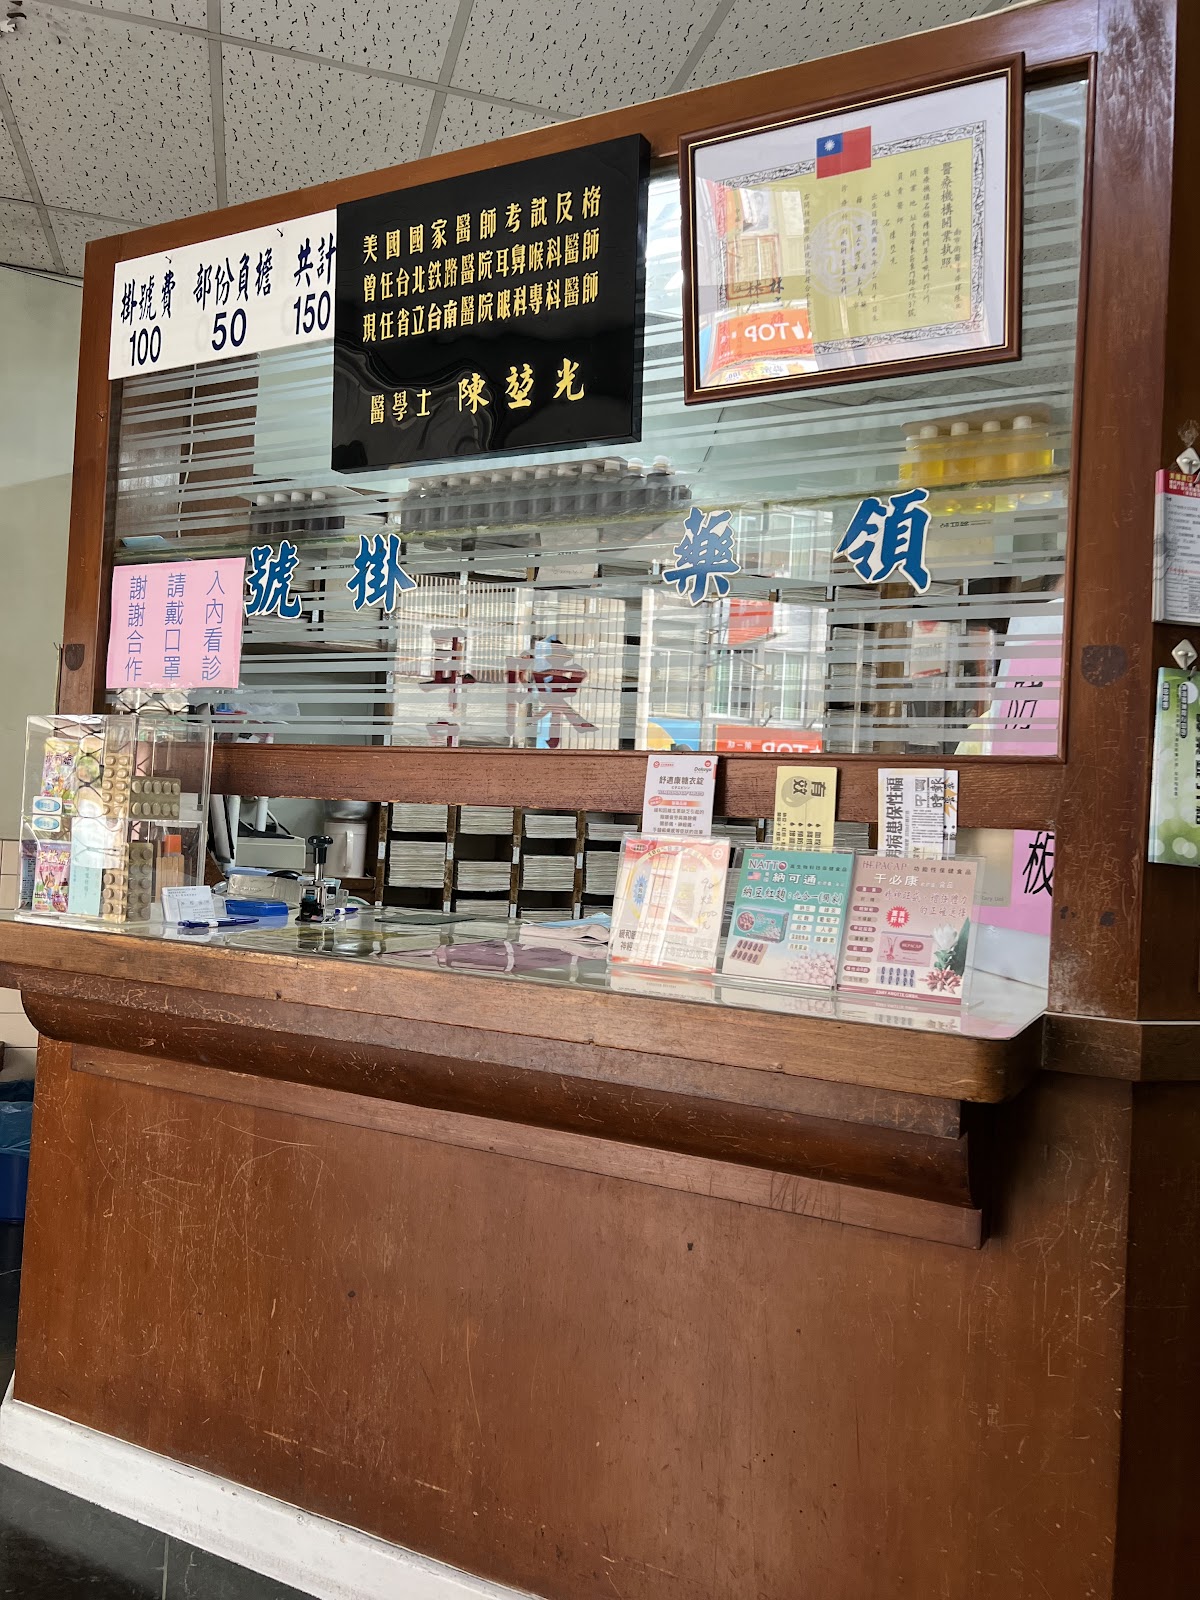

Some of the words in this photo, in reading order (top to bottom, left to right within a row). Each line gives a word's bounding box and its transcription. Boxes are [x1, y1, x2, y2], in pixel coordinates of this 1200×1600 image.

[363, 185, 601, 264] 美國國家醫師考試及格
[120, 269, 177, 327] 掛號費
[293, 232, 337, 288] 共計
[362, 270, 600, 343] 現任省立台南醫院眼科專科醫師
[130, 325, 162, 367] 100
[211, 308, 247, 351] 50
[293, 290, 331, 336] 150
[370, 388, 432, 425] 醫學士
[124, 574, 148, 682] 謝謝合作
[162, 572, 187, 682] 請戴口罩
[201, 570, 226, 682] 入內看診
[658, 775, 705, 786] 舒適康糖衣錠
[793, 779, 827, 798] 有效
[748, 859, 788, 871] NATTO
[771, 872, 817, 886] 納可通
[862, 860, 908, 871] HEPACAP
[913, 866, 972, 876] 功能性保健食品
